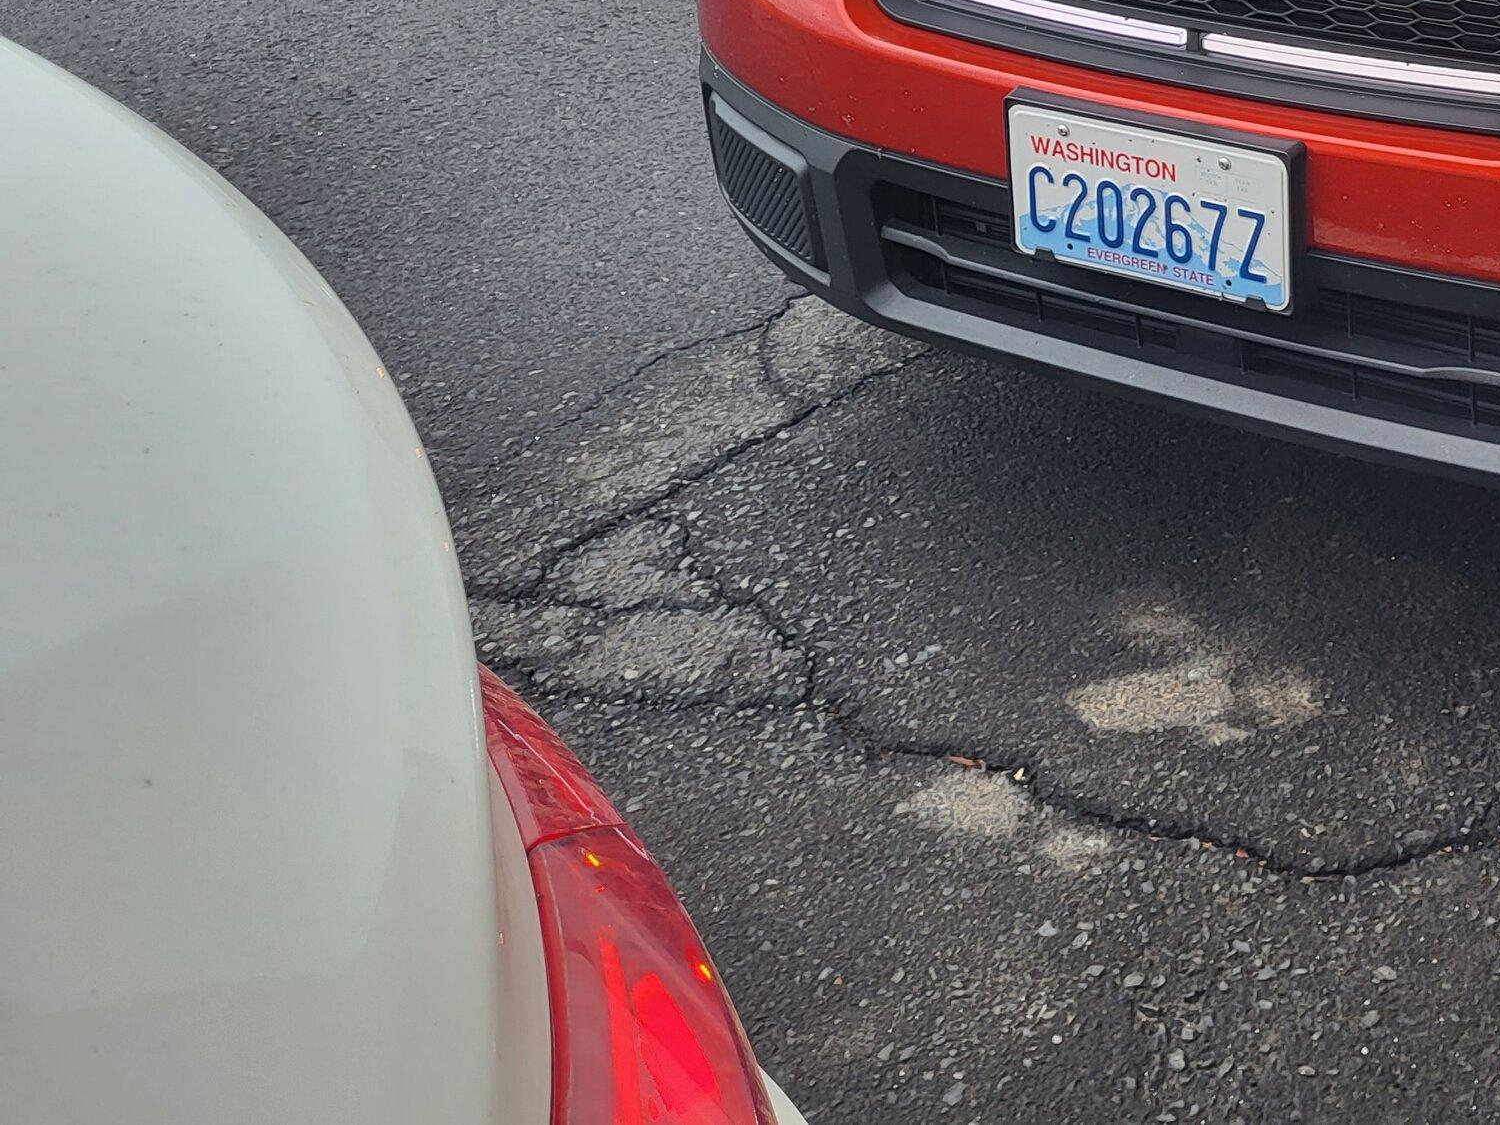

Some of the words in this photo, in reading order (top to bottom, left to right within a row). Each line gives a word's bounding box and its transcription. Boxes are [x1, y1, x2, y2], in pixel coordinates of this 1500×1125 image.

[1030, 135, 1177, 182] WASHINGTON
[1028, 165, 1267, 284] C20267Z
[1087, 247, 1168, 274] EVERGREEN
[1173, 266, 1215, 286] STATE
